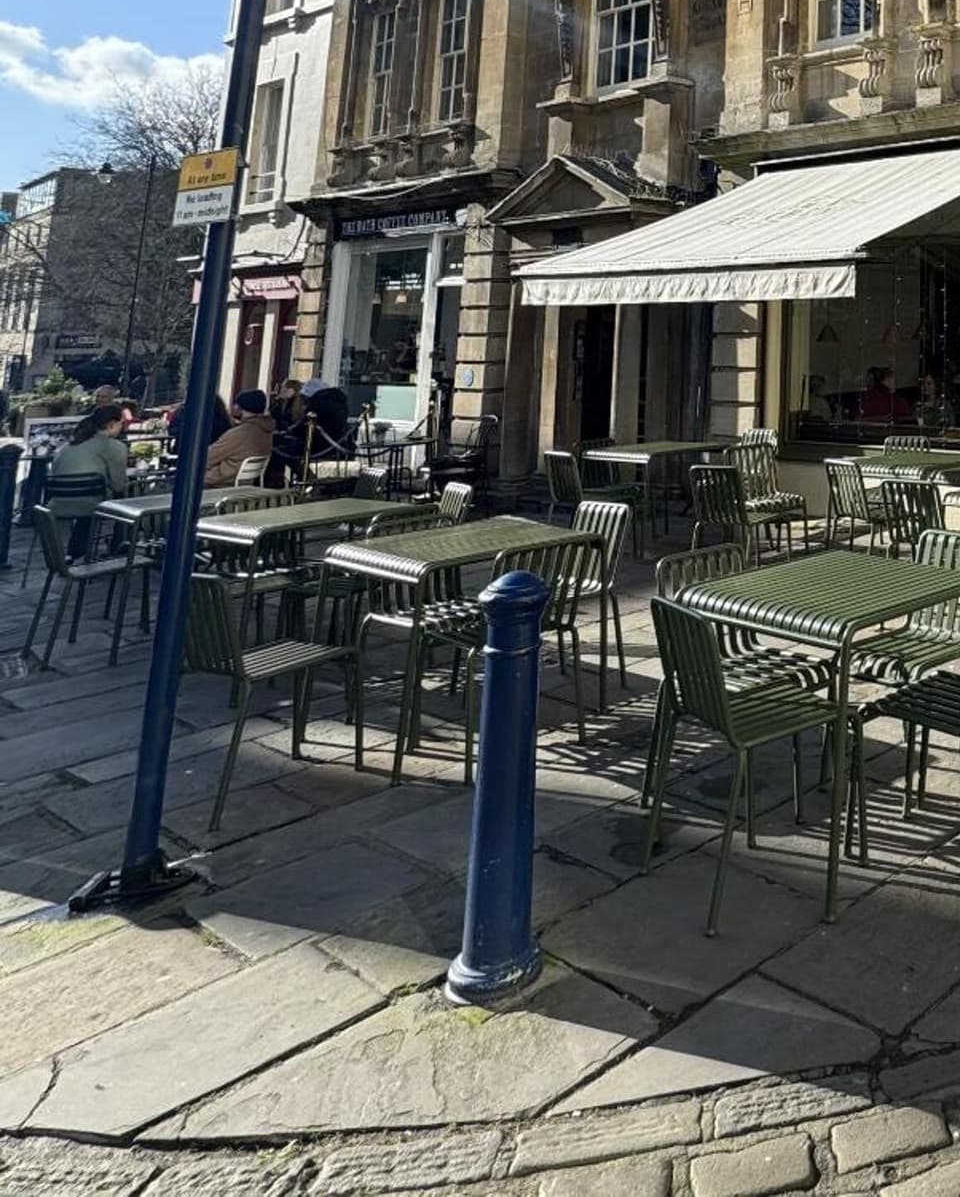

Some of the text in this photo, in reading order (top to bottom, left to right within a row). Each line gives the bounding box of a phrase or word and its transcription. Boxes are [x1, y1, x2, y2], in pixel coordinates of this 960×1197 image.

[197, 191, 223, 203] loading
[378, 215, 406, 229] COFFEE
[408, 210, 446, 225] COMPANY
